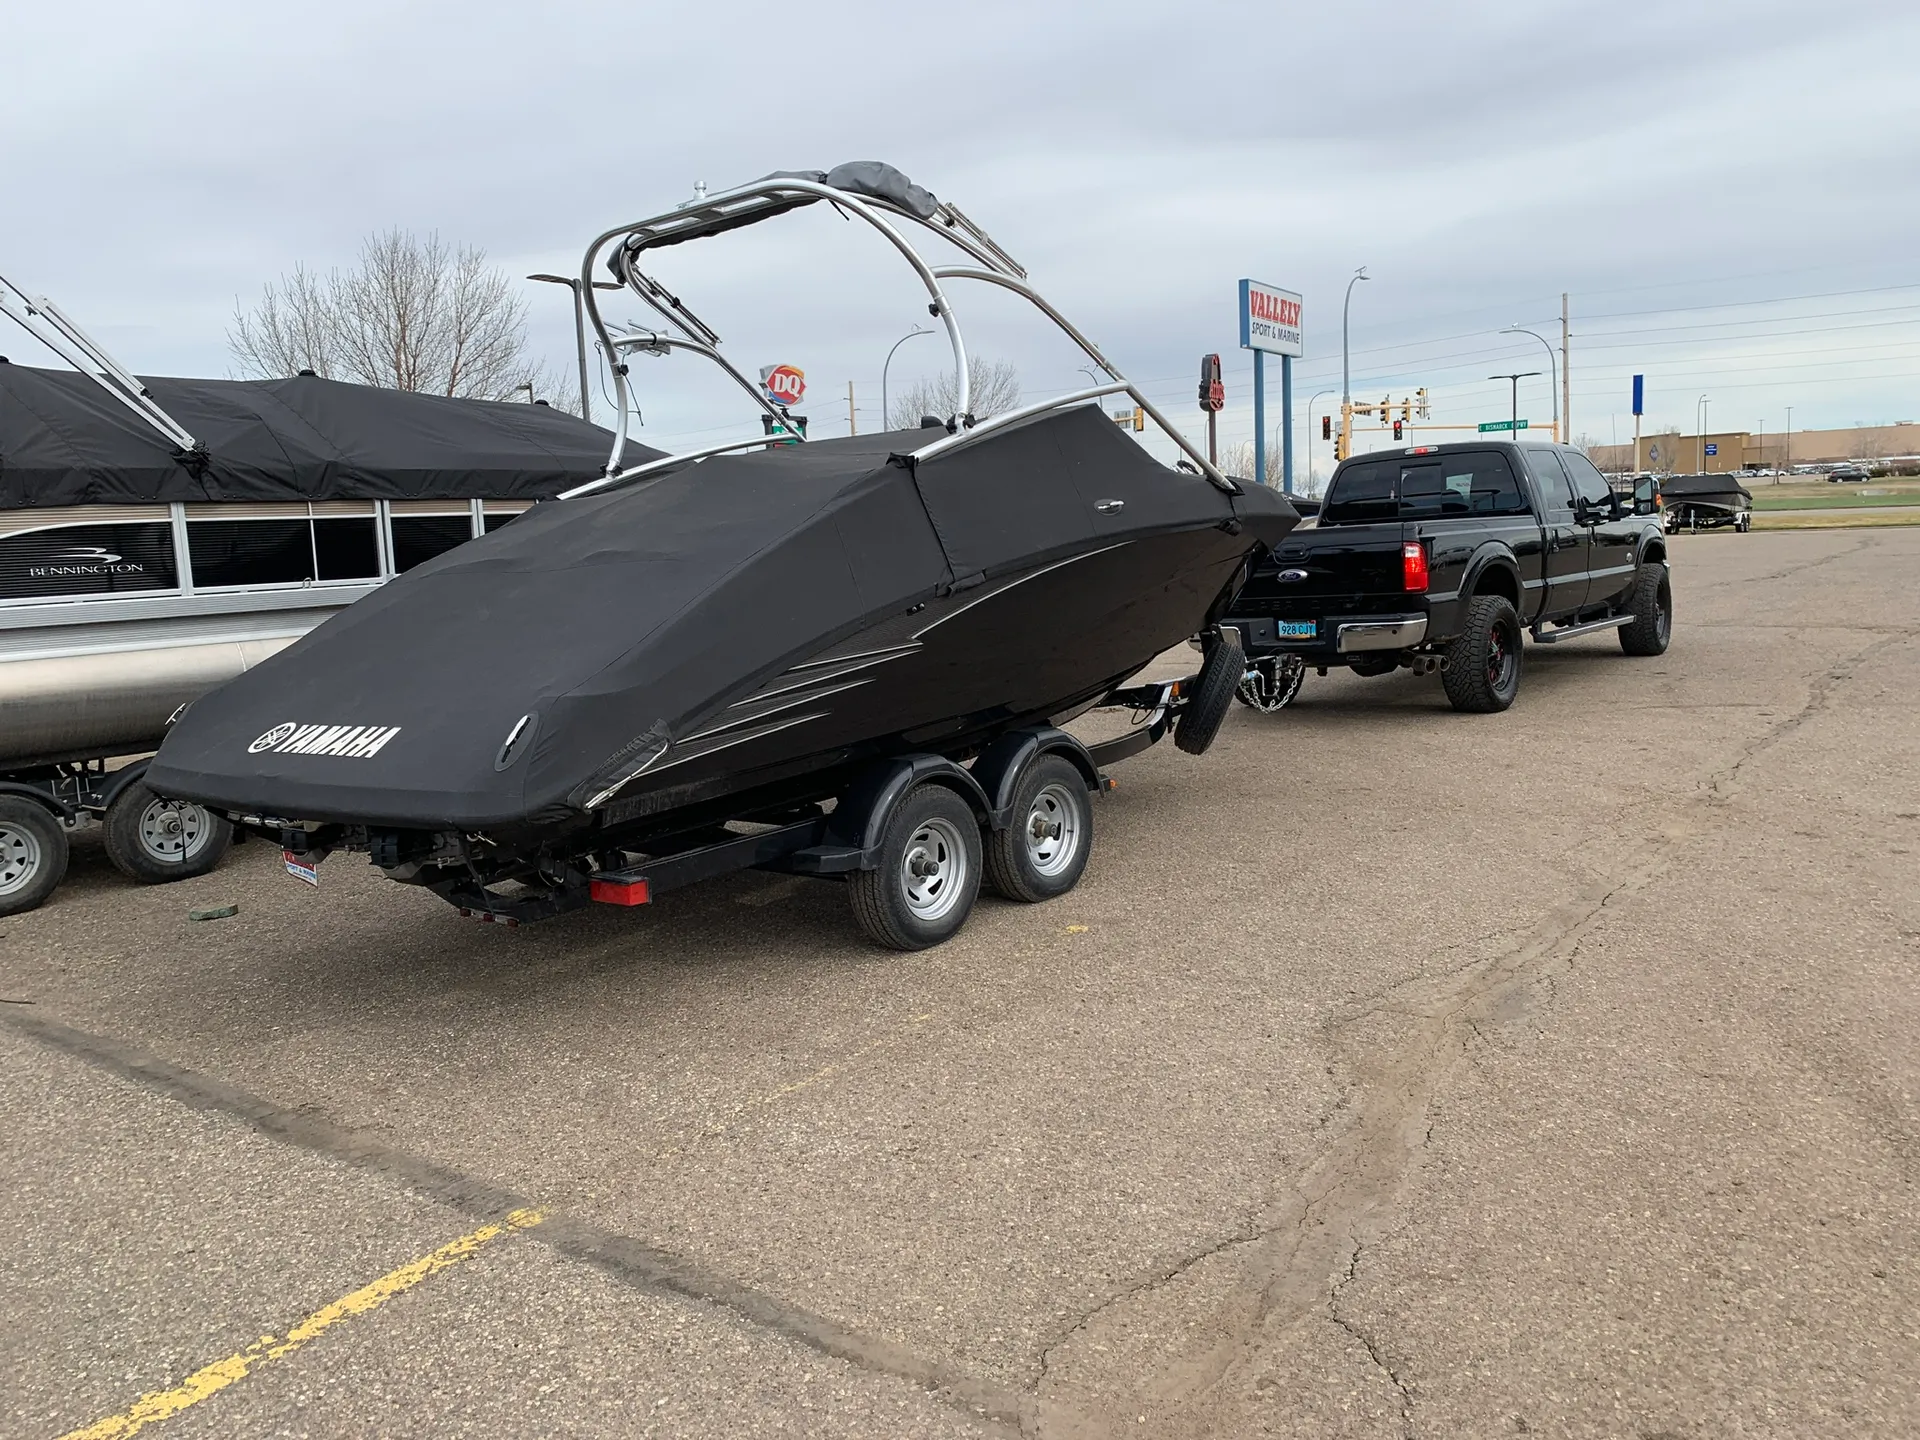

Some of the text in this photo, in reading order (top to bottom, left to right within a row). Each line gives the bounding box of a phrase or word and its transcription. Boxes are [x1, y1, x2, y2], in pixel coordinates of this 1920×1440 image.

[1250, 289, 1301, 328] VALLELY
[1252, 322, 1300, 345] SPORT & MARINE
[774, 373, 801, 397] DQ
[1485, 423, 1509, 431] BISMARCK
[29, 564, 143, 577] BENNINGTON
[1281, 625, 1315, 635] 928 CJY
[272, 725, 402, 758] YAMAHA
